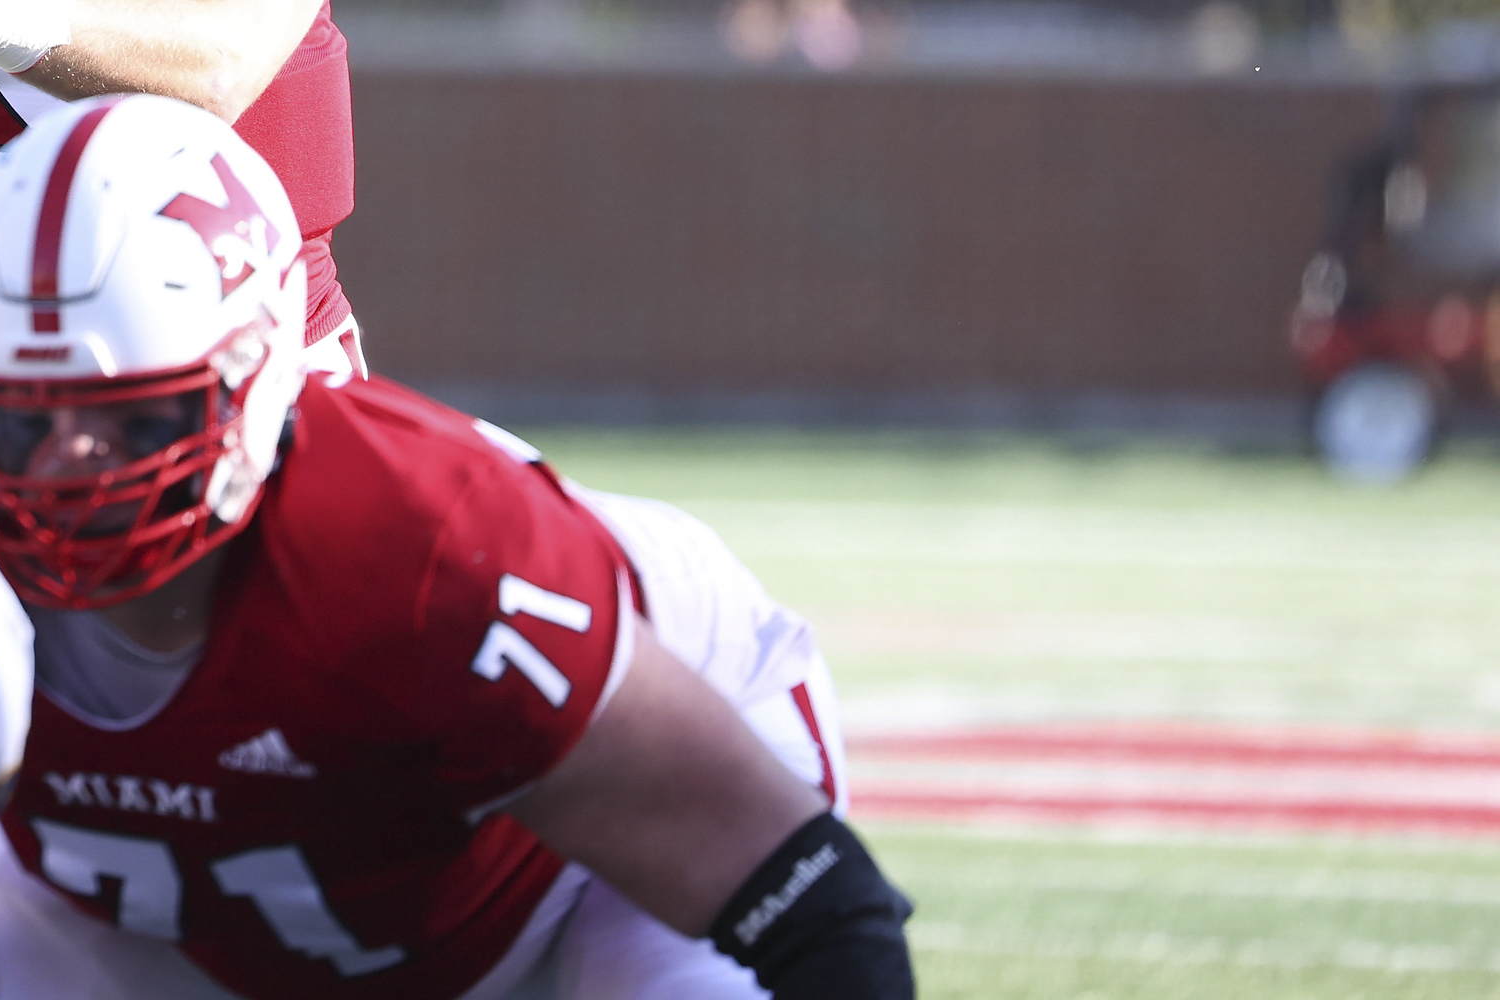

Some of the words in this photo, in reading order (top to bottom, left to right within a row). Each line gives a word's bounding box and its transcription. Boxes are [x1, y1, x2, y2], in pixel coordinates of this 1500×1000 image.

[471, 573, 592, 709] 71
[44, 771, 217, 823] MIAMI
[31, 816, 406, 978] 71
